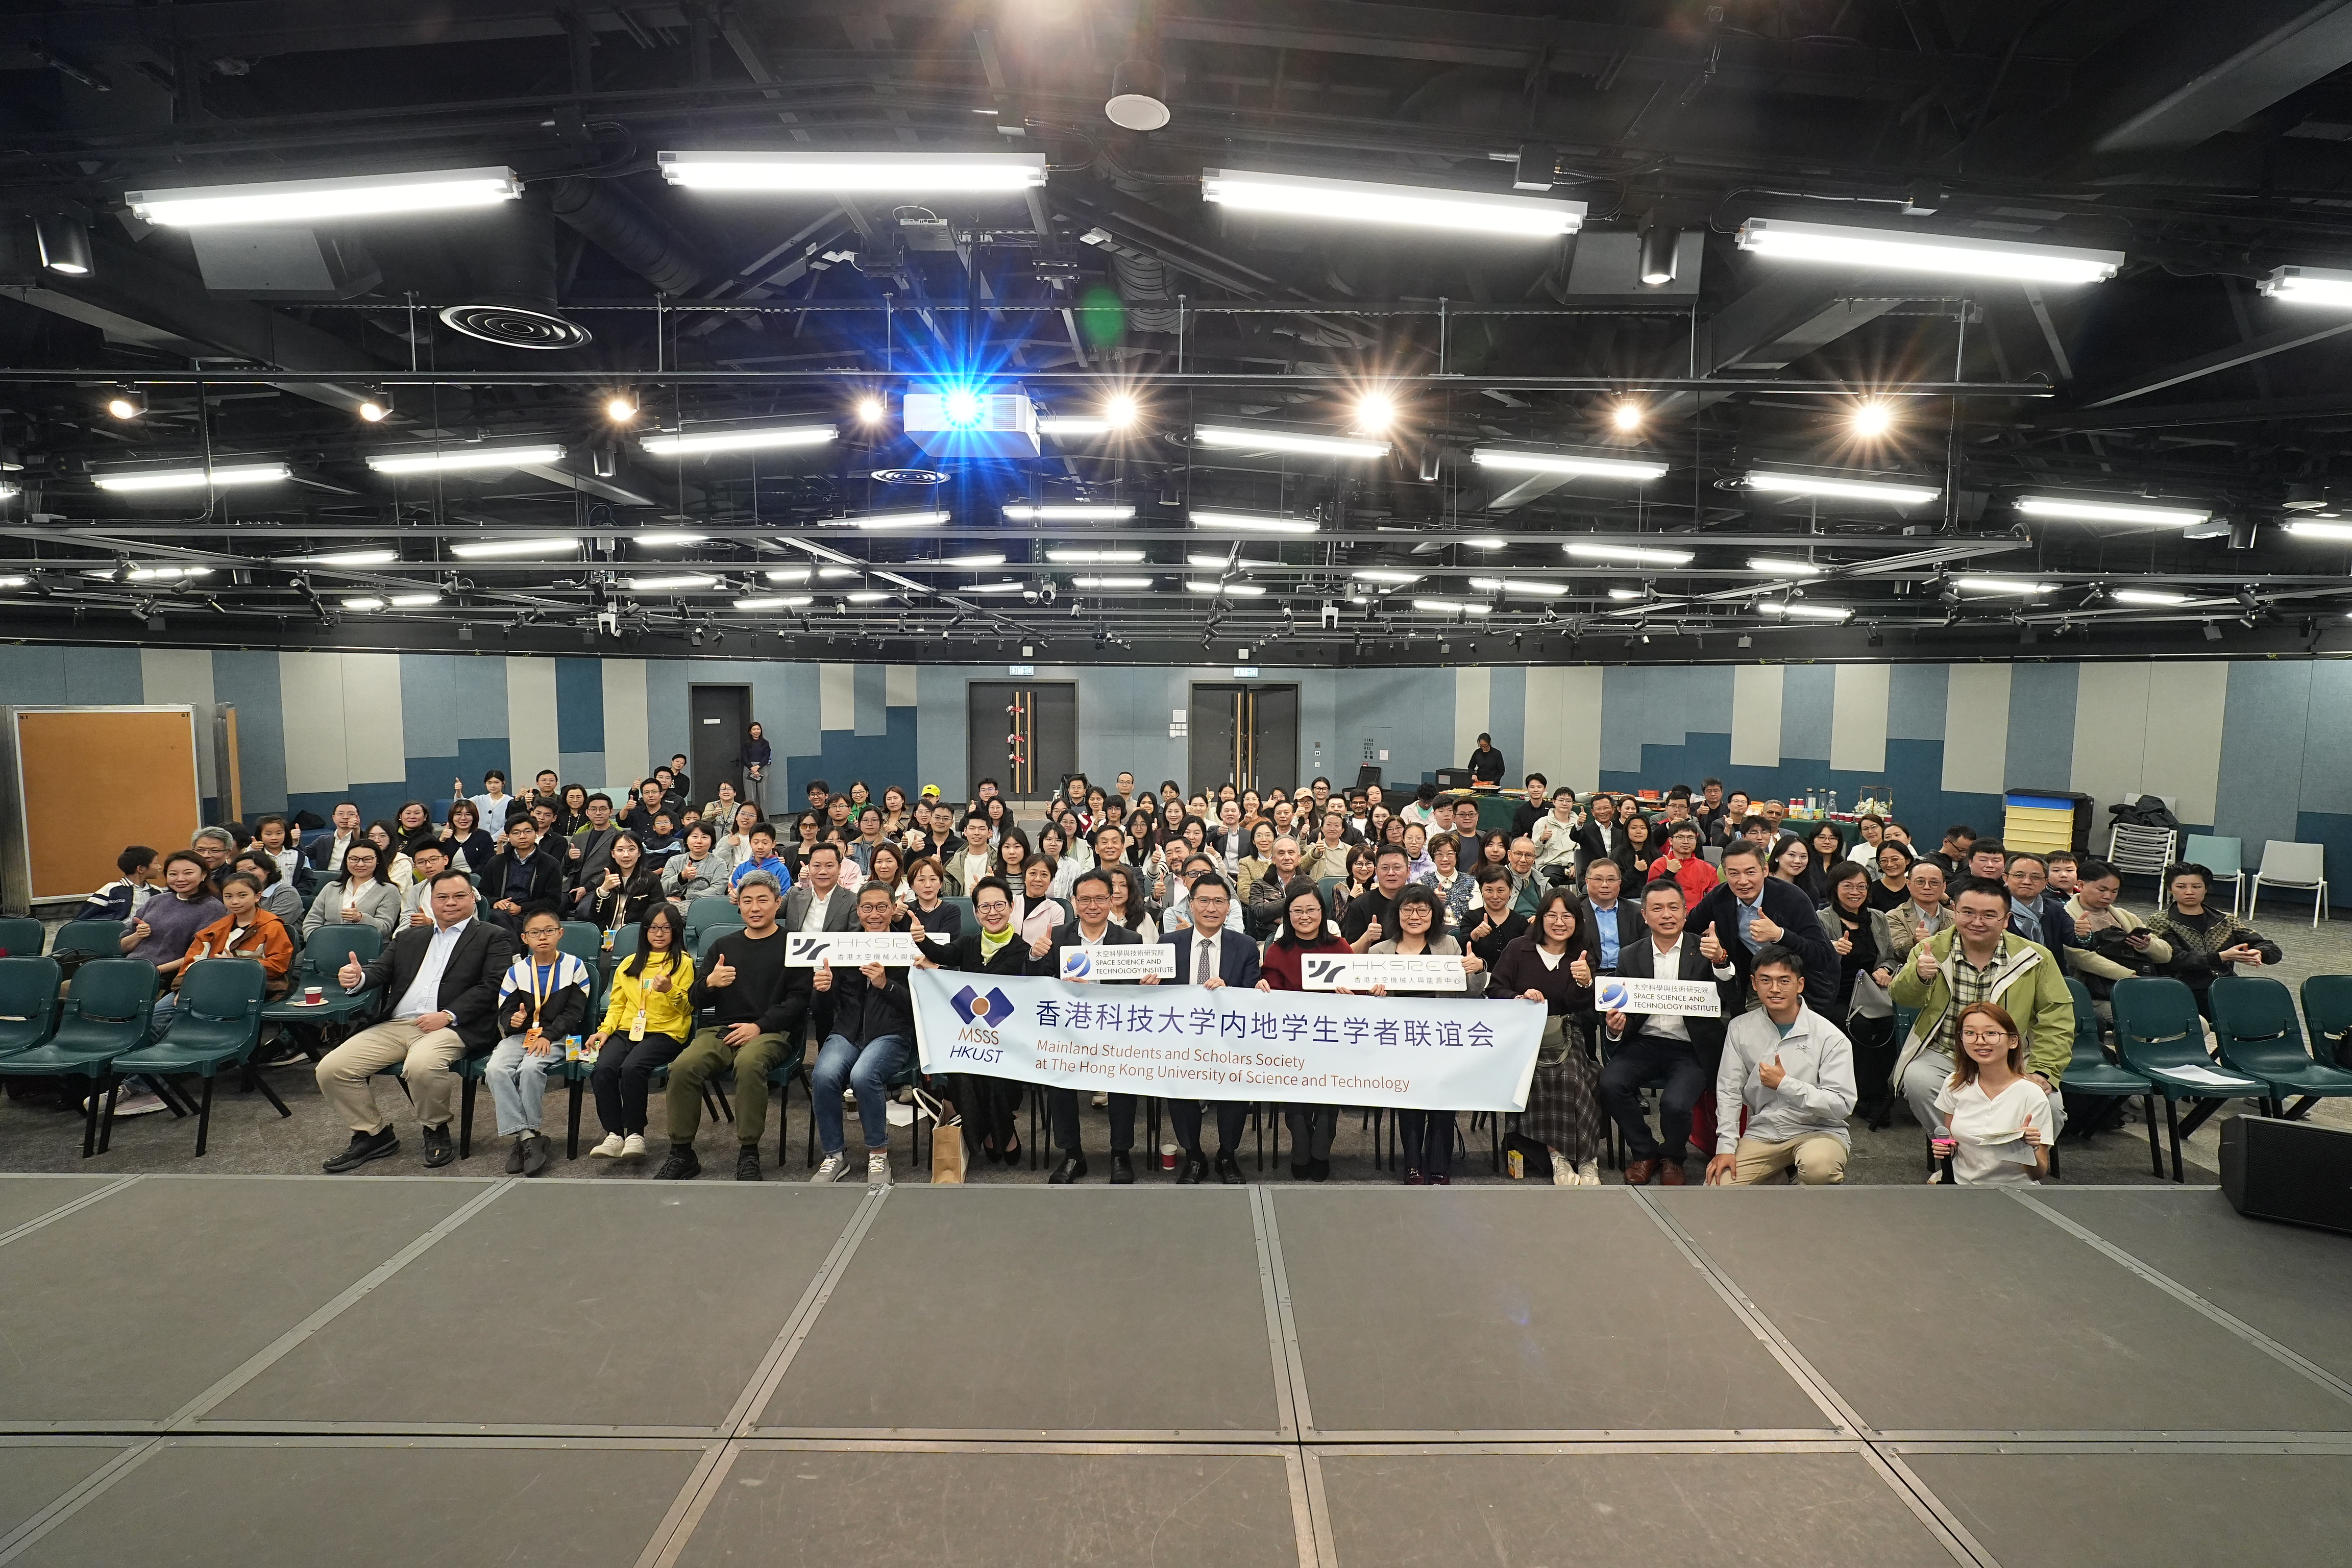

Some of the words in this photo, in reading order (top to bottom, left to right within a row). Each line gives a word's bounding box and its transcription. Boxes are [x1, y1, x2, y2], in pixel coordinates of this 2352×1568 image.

[1235, 668, 1246, 676] EXIT
[1247, 668, 1257, 676] 出口
[1095, 949, 1165, 958] 太空科學與技術研究院
[1352, 960, 1460, 972] HKSREC
[1354, 976, 1461, 985] 香港太空機械人與能源中心
[1633, 983, 1709, 994] 太空科學與技術研究院
[1633, 1001, 1683, 1011] TECHNOLOGY
[1684, 1004, 1719, 1012] INSTITUTE
[1036, 1000, 1494, 1048] 香港科技大学内地学生学者联谊会
[958, 1026, 1000, 1045] MSSS
[949, 1045, 1004, 1064] HKUST
[1037, 1039, 1098, 1056] Mainland
[1101, 1044, 1162, 1060] Students
[1165, 1047, 1190, 1061] and
[1194, 1049, 1253, 1065] Scholars
[1256, 1054, 1305, 1071] Society
[1035, 1058, 1047, 1070] at
[1051, 1058, 1075, 1072] The
[1080, 1061, 1116, 1078] Hong
[1119, 1063, 1154, 1081] Kong
[1157, 1065, 1226, 1085] University
[1229, 1069, 1243, 1083] of
[1246, 1071, 1298, 1086] Science
[1302, 1074, 1327, 1087] and
[1330, 1075, 1410, 1093] Technology
